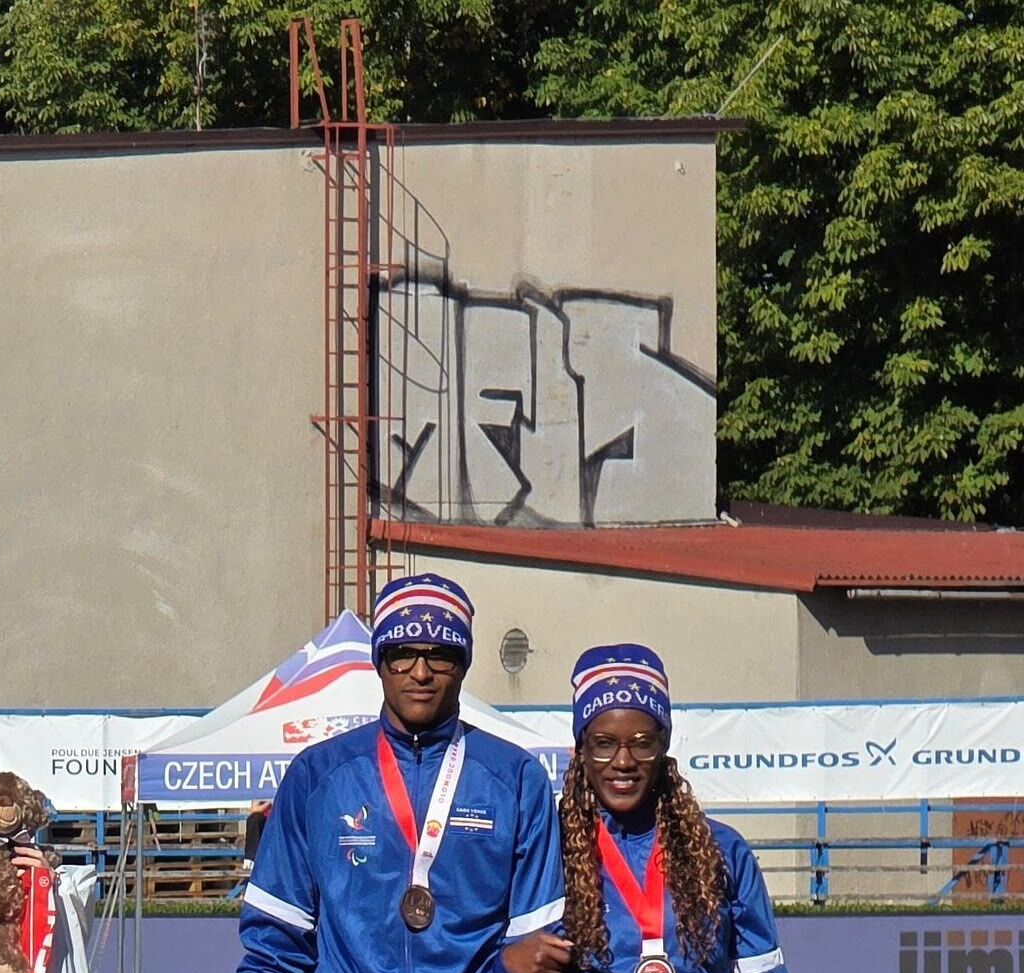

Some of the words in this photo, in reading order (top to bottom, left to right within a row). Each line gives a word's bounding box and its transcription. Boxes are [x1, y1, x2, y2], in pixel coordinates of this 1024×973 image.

[582, 690, 632, 719] CABO
[51, 749, 79, 757] POUL
[80, 749, 100, 757] DUE
[689, 752, 860, 769] GRUNDFOS
[912, 748, 1021, 765] GRUND
[52, 759, 118, 776] FOUN
[164, 760, 251, 791] CZECH
[258, 760, 292, 790] AT
